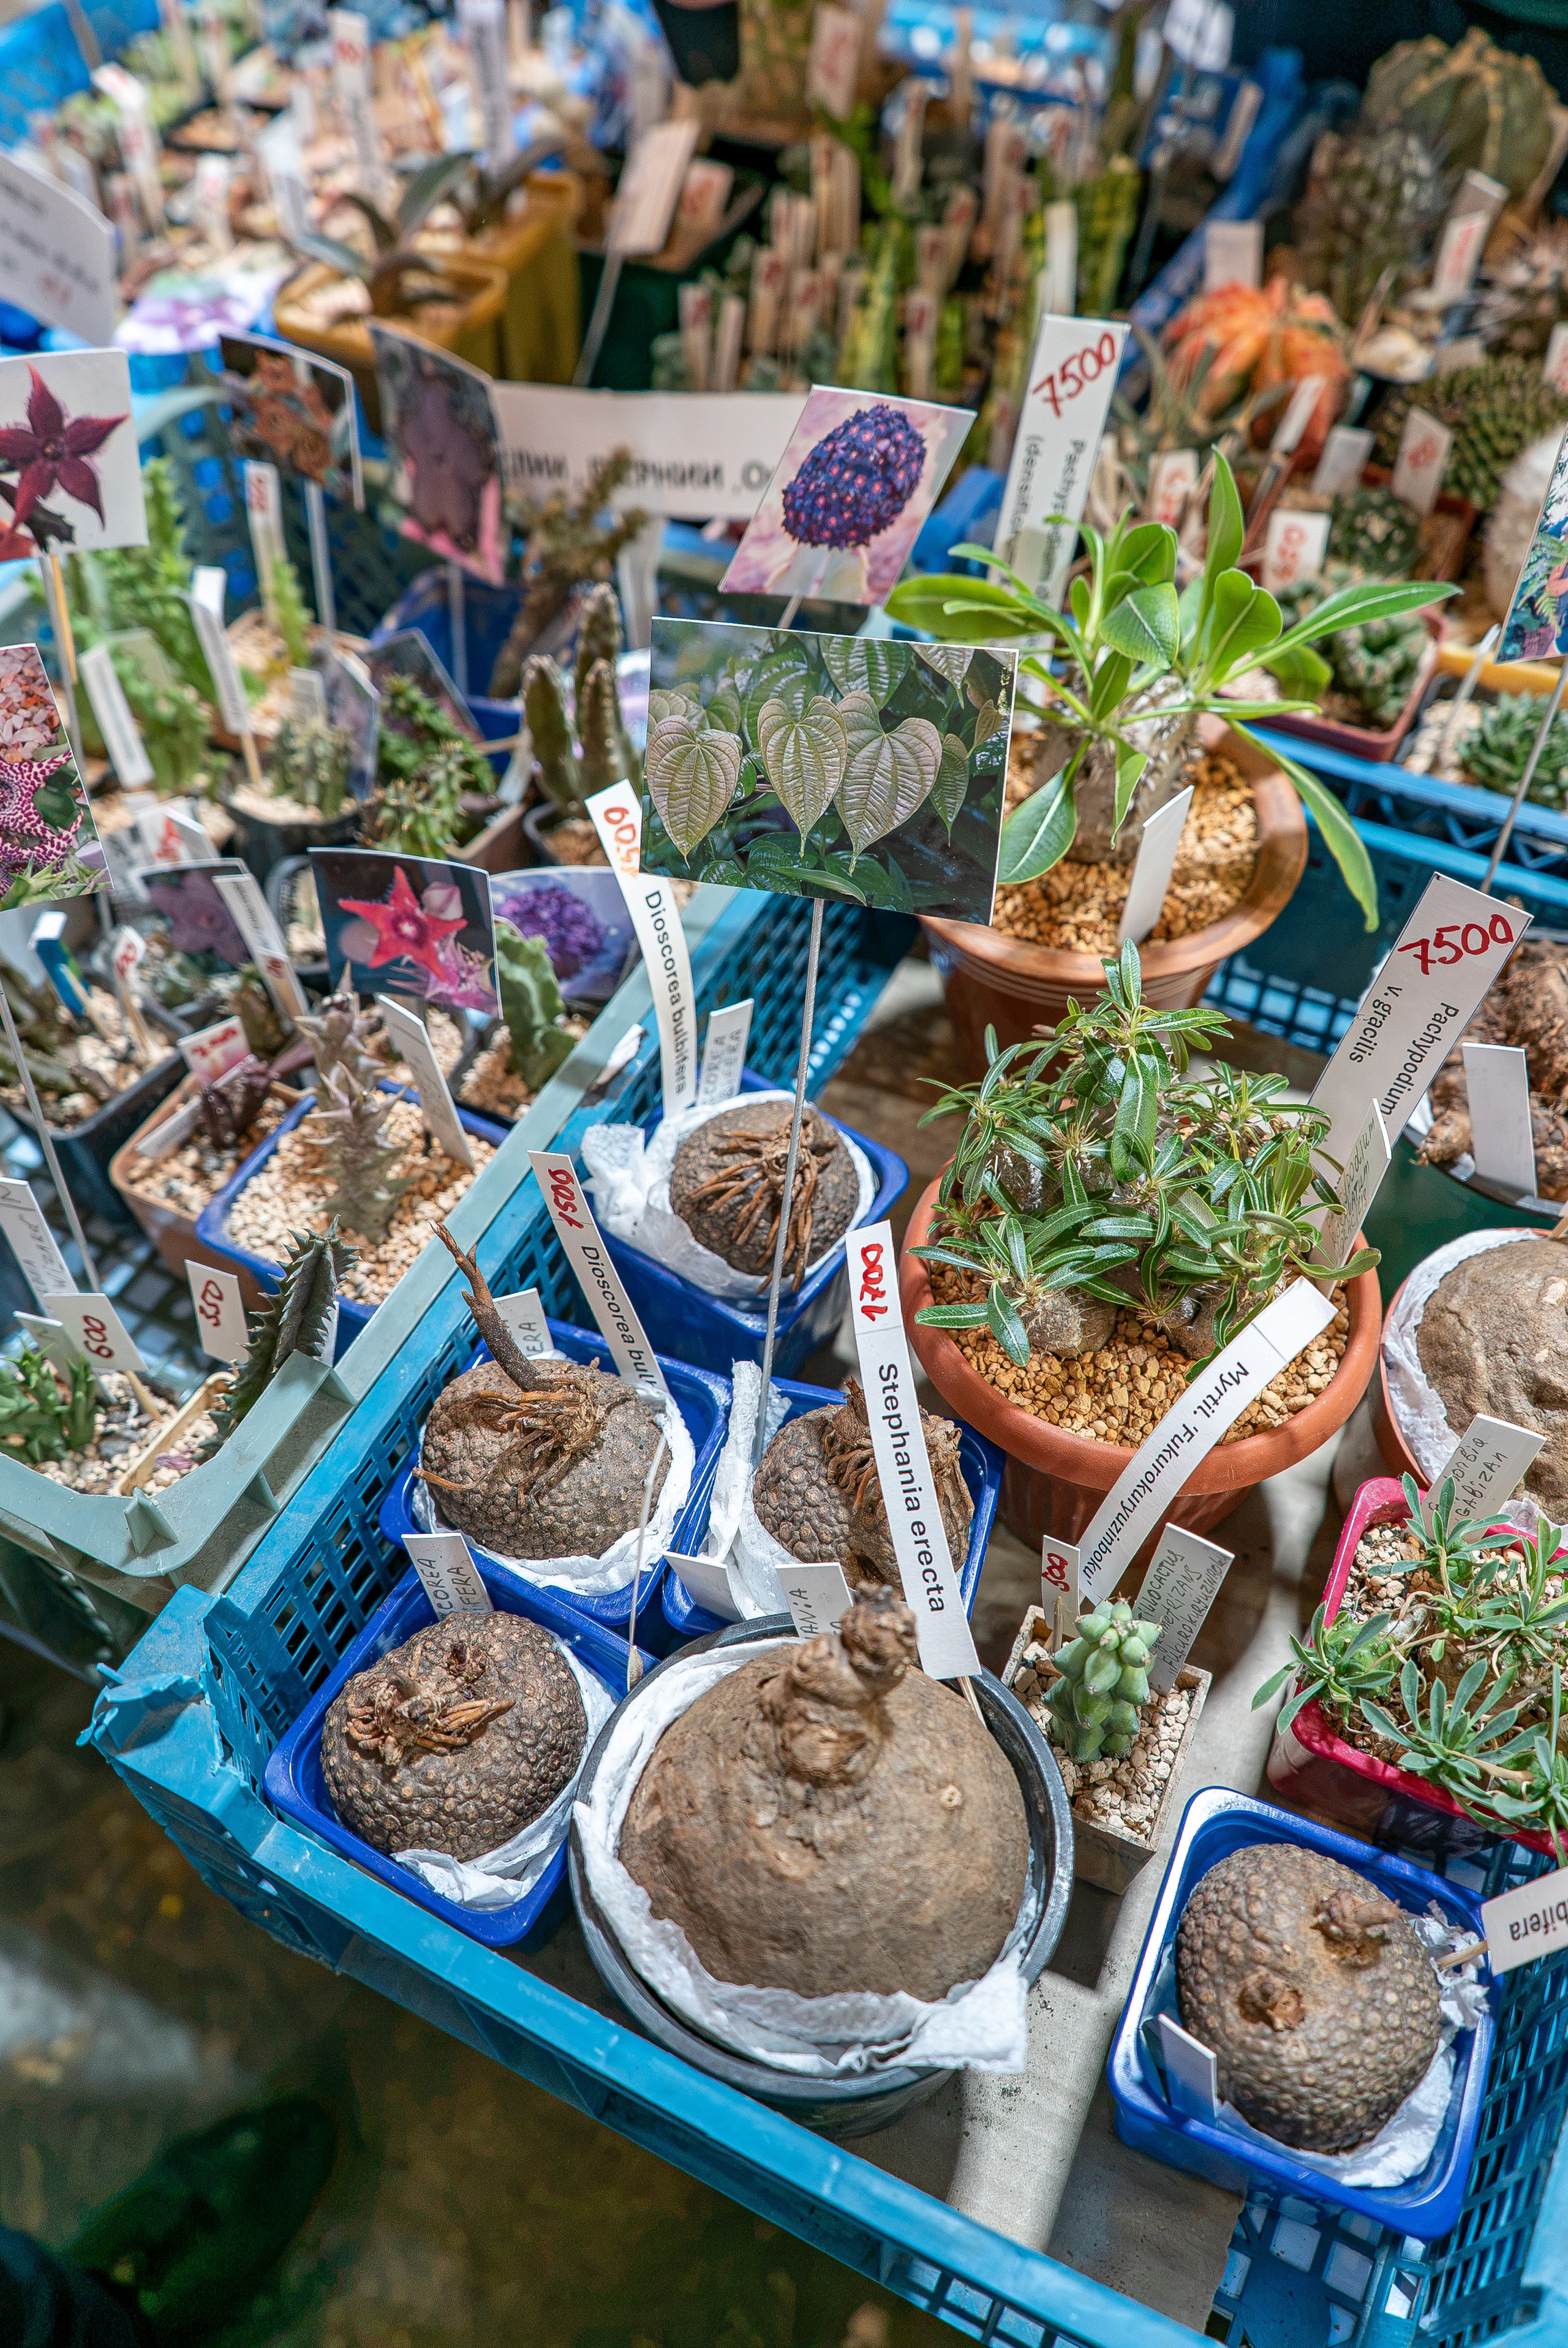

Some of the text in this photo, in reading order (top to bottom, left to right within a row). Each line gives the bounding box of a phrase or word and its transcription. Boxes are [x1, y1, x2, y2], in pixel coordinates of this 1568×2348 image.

[1031, 331, 1116, 419] 7500
[645, 890, 680, 1006] Dioscorea
[1397, 913, 1514, 975] 7500
[1349, 984, 1403, 1063] v. gracilis
[1380, 1002, 1460, 1116] Pachypodium
[548, 1168, 584, 1229] 1500
[581, 1245, 636, 1345] Dioscorea
[860, 1242, 888, 1323] 1700
[82, 1315, 115, 1359] 600
[1193, 1361, 1250, 1419] Myrtil.
[878, 1362, 946, 1613] Stephania erecta
[1041, 1552, 1071, 1593] 500
